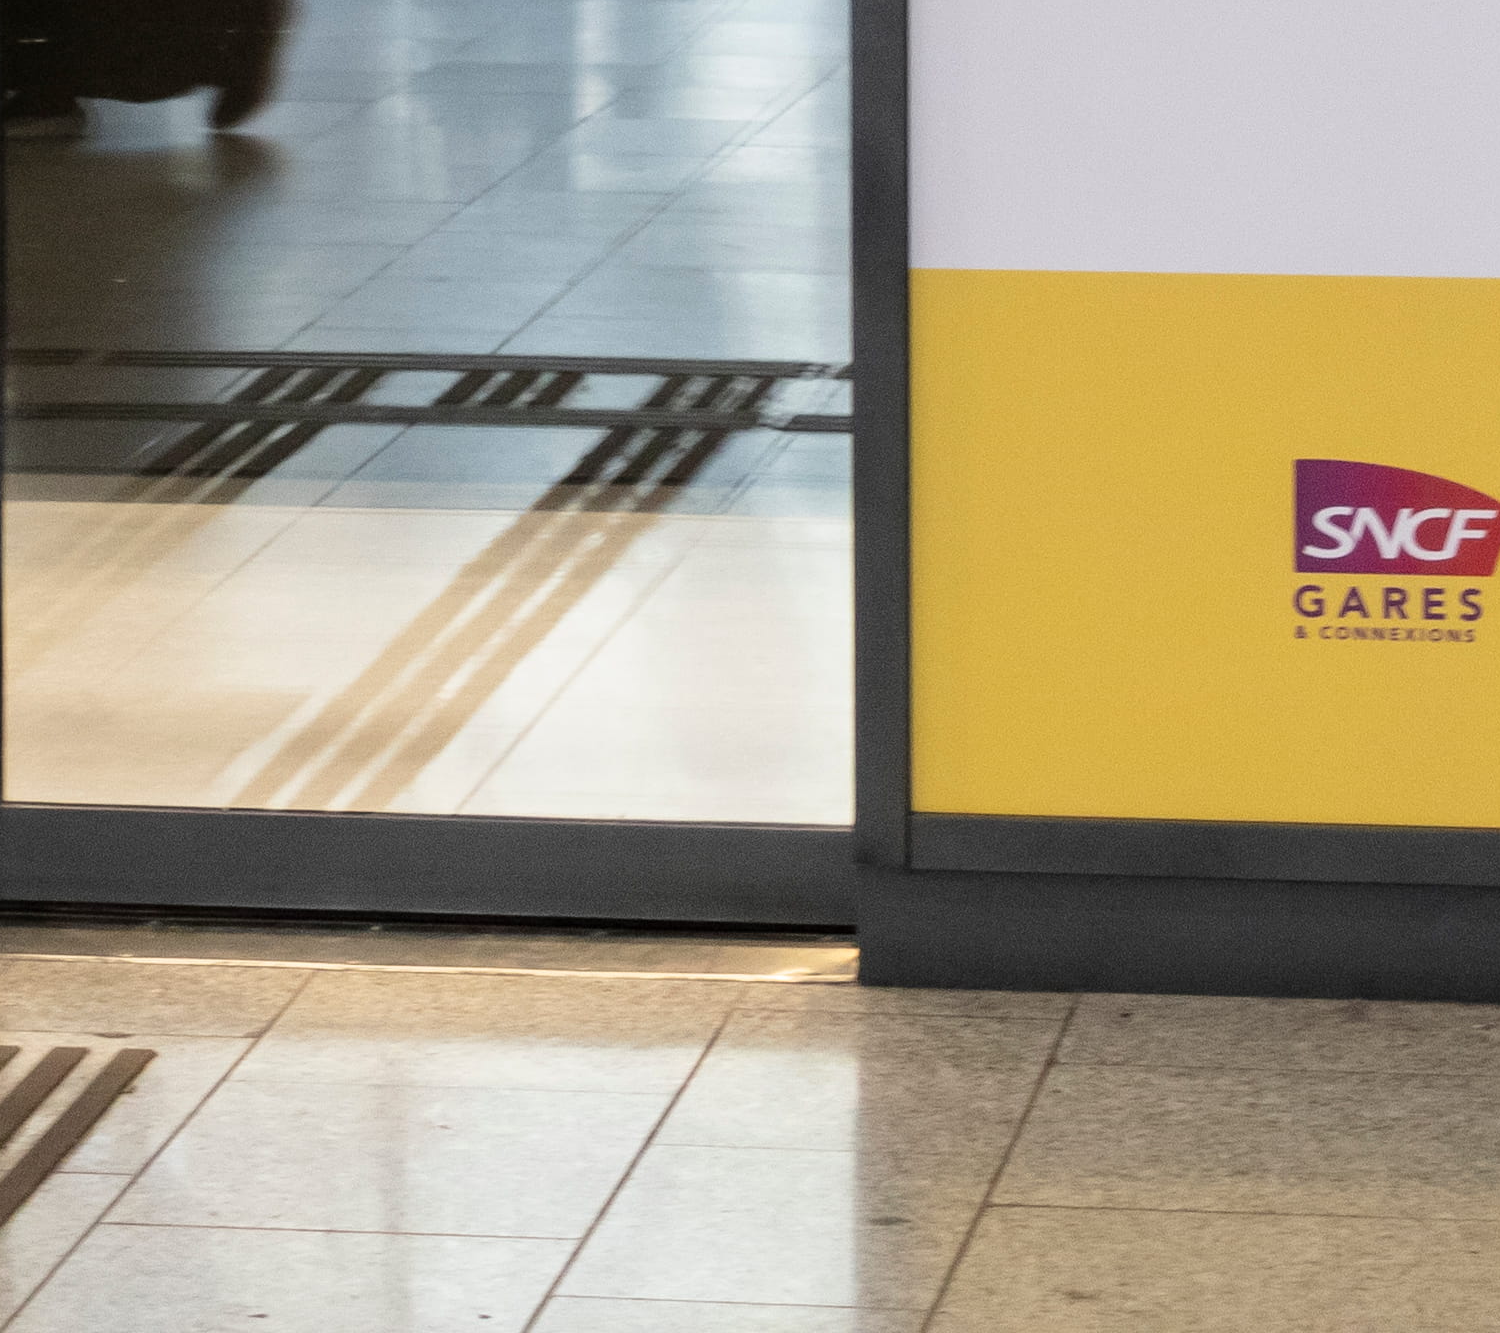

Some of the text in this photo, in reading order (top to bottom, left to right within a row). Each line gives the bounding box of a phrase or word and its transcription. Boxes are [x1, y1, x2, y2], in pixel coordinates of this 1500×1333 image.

[1302, 505, 1499, 561] SNCF
[1293, 584, 1483, 622] GARES
[1293, 625, 1476, 643] & CONNEXIONS
